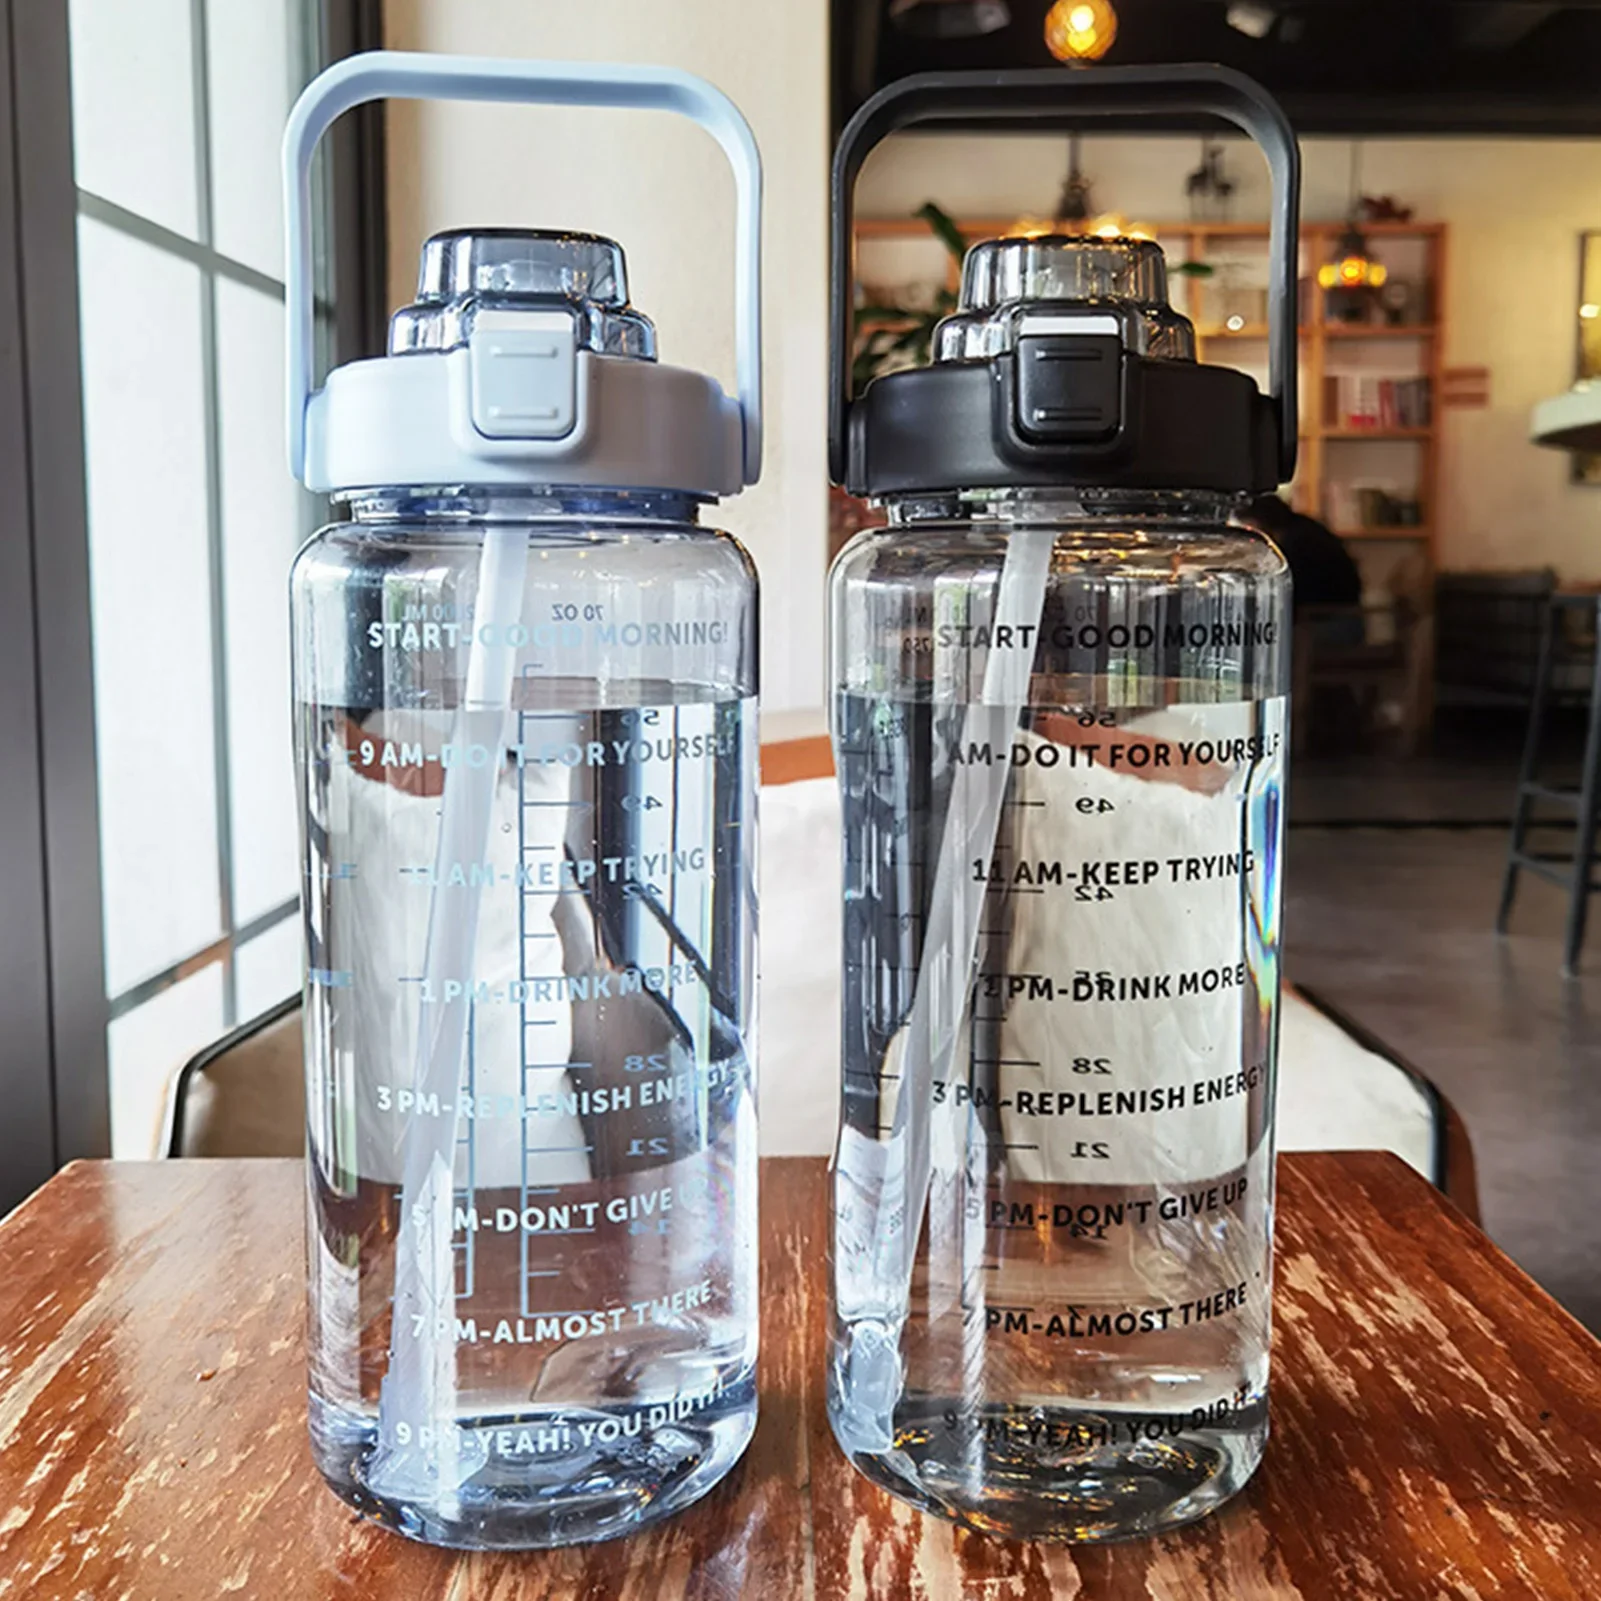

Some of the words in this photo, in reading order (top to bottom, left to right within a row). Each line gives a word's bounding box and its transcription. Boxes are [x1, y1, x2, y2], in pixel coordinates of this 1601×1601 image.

[594, 621, 728, 647] MORNING!
[937, 624, 1155, 649] START-GOOD
[360, 740, 375, 766] 9
[380, 741, 488, 769] AM-DO
[1070, 745, 1100, 768] IT
[1110, 744, 1171, 768] FOR
[1178, 733, 1280, 765] YOURSELF
[447, 861, 597, 887] AM-KEEP
[603, 848, 705, 882] TRYING
[1014, 860, 1159, 885] AM-KEEP
[1167, 849, 1255, 882] TRYING
[444, 976, 612, 1003] PM-DRINK
[619, 961, 697, 997] MORE
[1008, 975, 1171, 1002] PM-DRINK
[1179, 963, 1245, 996] MORE
[376, 1086, 391, 1110] 3
[398, 1085, 632, 1119] PM-REPLENISH
[639, 1059, 730, 1107] ENEGY
[932, 1080, 946, 1103] 3
[955, 1084, 1185, 1116] PM-REPLENISH
[437, 1202, 600, 1232] M-DON'T
[606, 1187, 673, 1223] GIVE
[991, 1200, 1155, 1228] PM-DON'T
[1160, 1188, 1218, 1220] GIVE
[1223, 1177, 1248, 1206] UP
[411, 1314, 426, 1338] 7
[434, 1308, 626, 1344] PM-ALMOST
[632, 1279, 712, 1326] THERE
[986, 1308, 1173, 1338] PM-ALMOST
[1179, 1282, 1247, 1325] THERE
[578, 1411, 642, 1447] YOU
[649, 1397, 694, 1430] DID
[1126, 1412, 1184, 1444] YOU
[1191, 1397, 1229, 1431] DID
